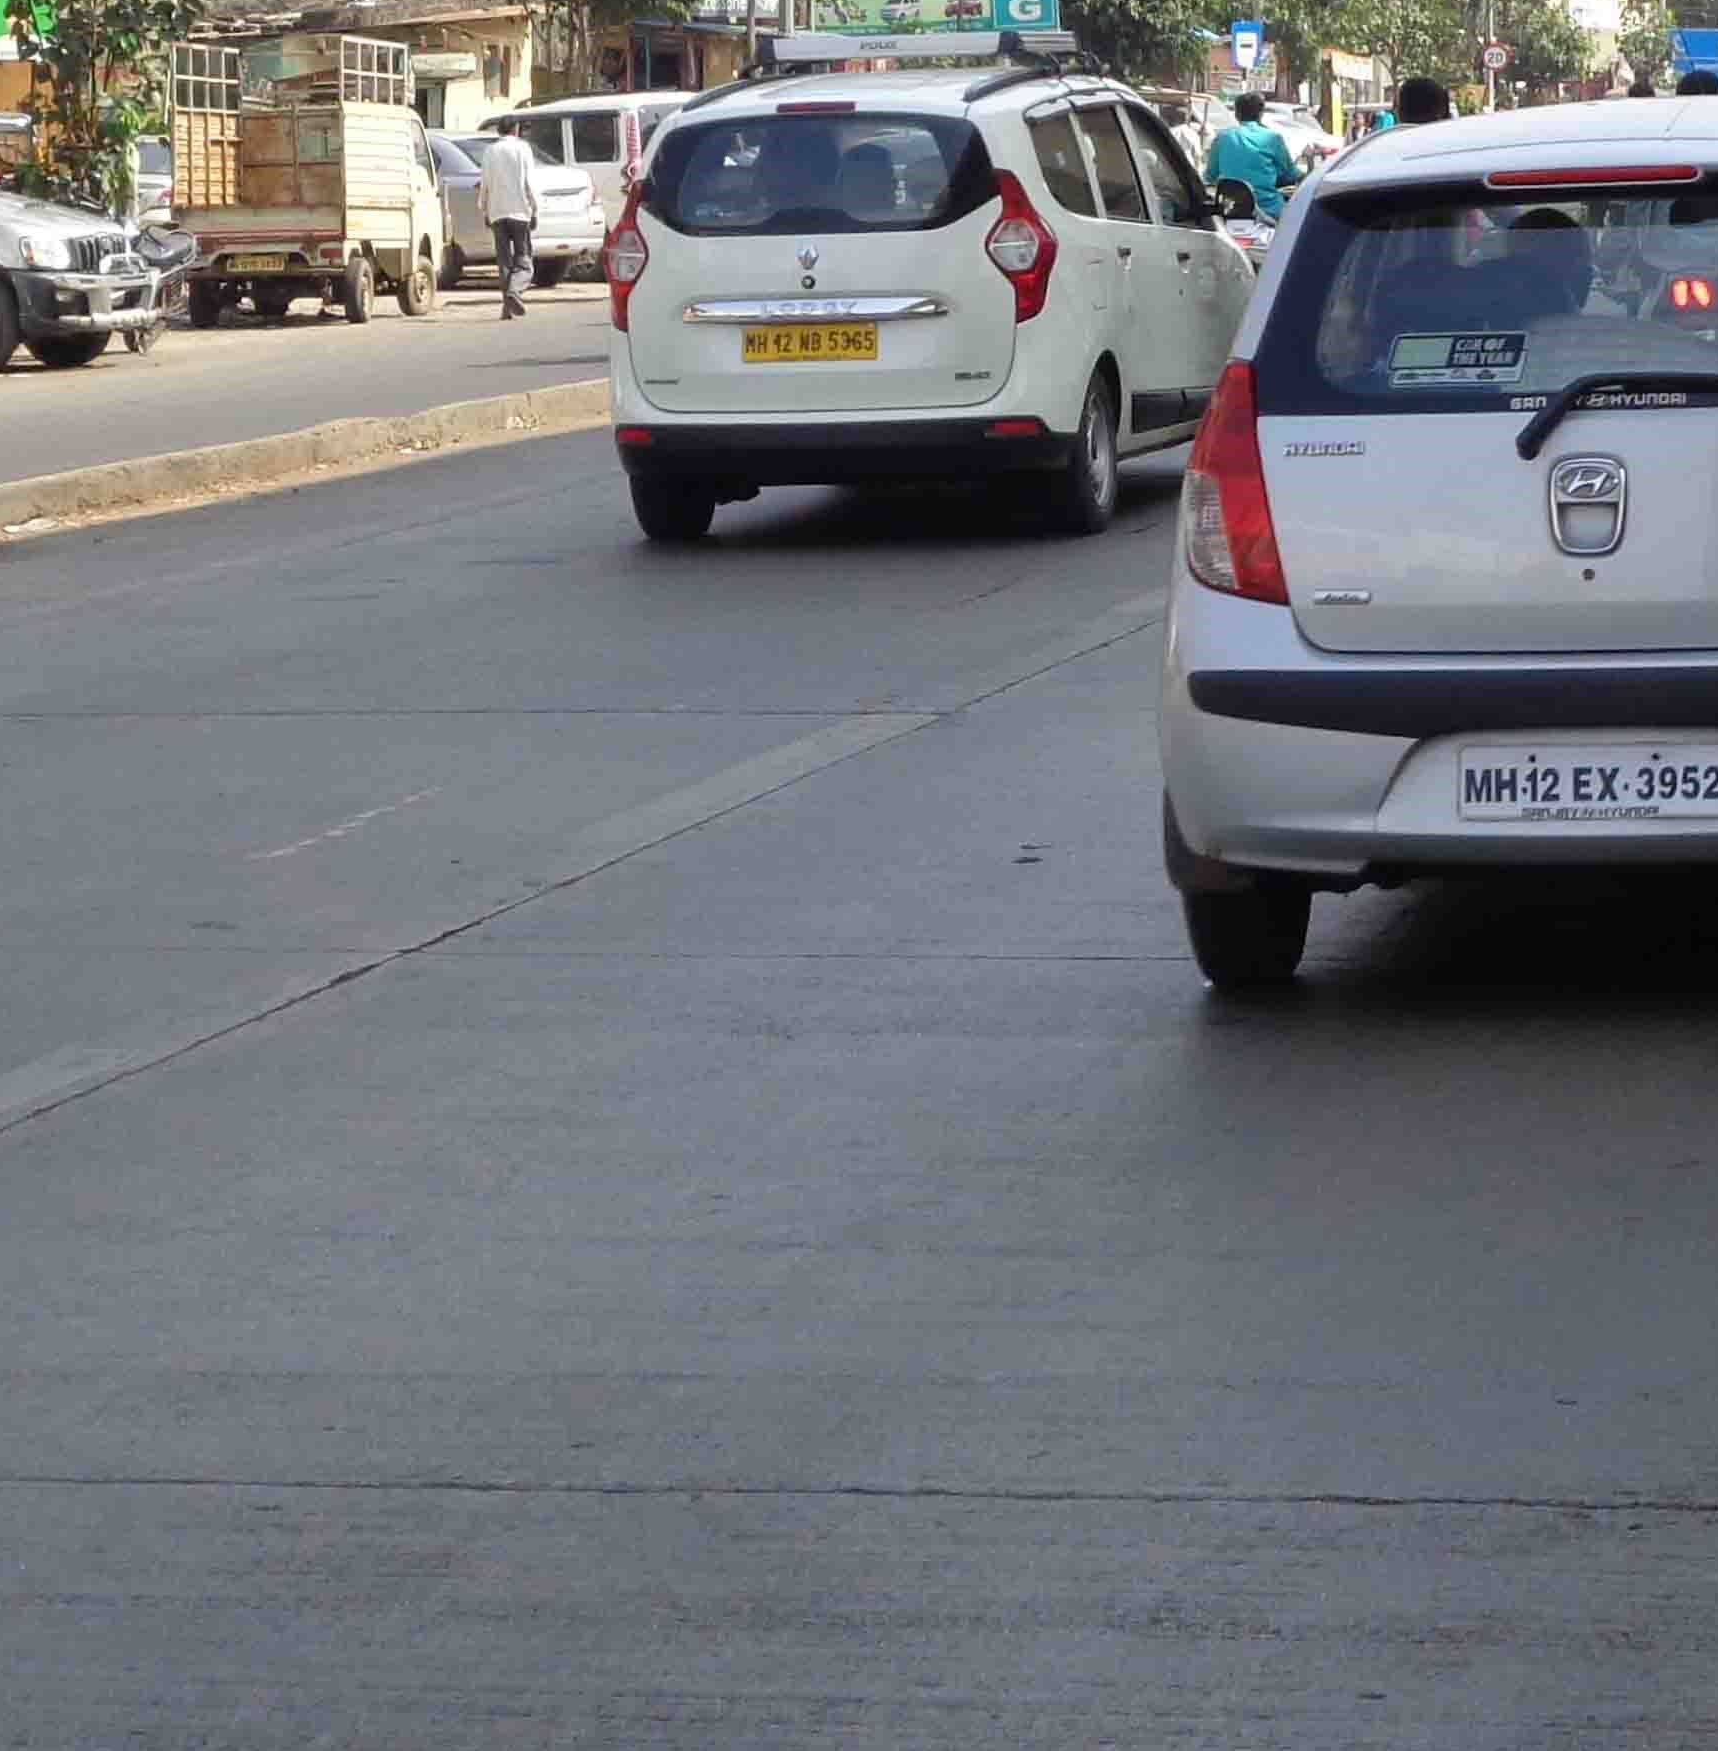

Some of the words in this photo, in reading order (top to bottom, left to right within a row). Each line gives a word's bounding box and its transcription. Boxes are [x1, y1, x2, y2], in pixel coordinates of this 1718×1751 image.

[745, 332, 768, 354] MH
[1455, 338, 1483, 351] CAR
[1452, 352, 1477, 365] THE
[1480, 351, 1515, 364] YEAR
[1608, 392, 1687, 407] HYUNDAI
